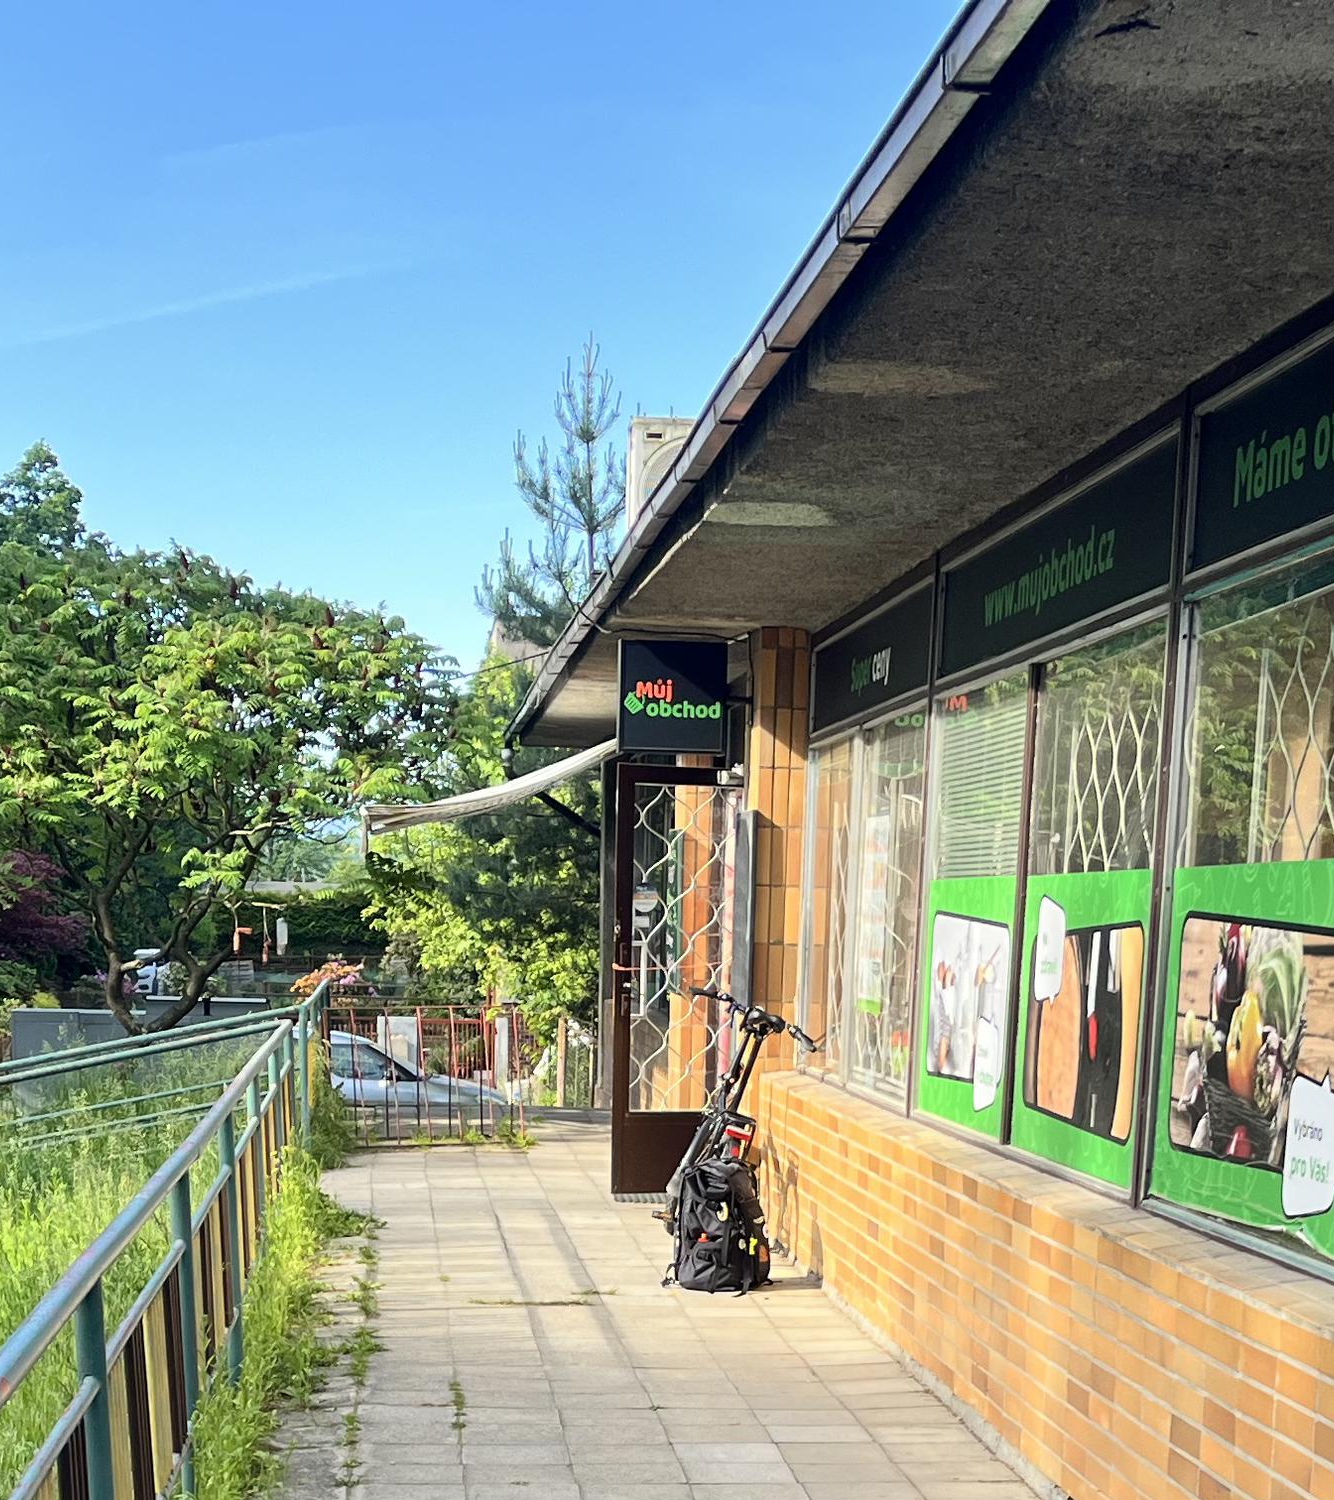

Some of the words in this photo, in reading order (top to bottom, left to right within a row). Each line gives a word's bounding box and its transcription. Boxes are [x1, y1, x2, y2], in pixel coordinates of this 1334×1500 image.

[1231, 427, 1307, 508] Máme
[984, 524, 1116, 628] www.mujobchod.cz
[635, 678, 673, 703] Můj
[645, 699, 721, 719] obchod
[1289, 1156, 1307, 1180] pro
